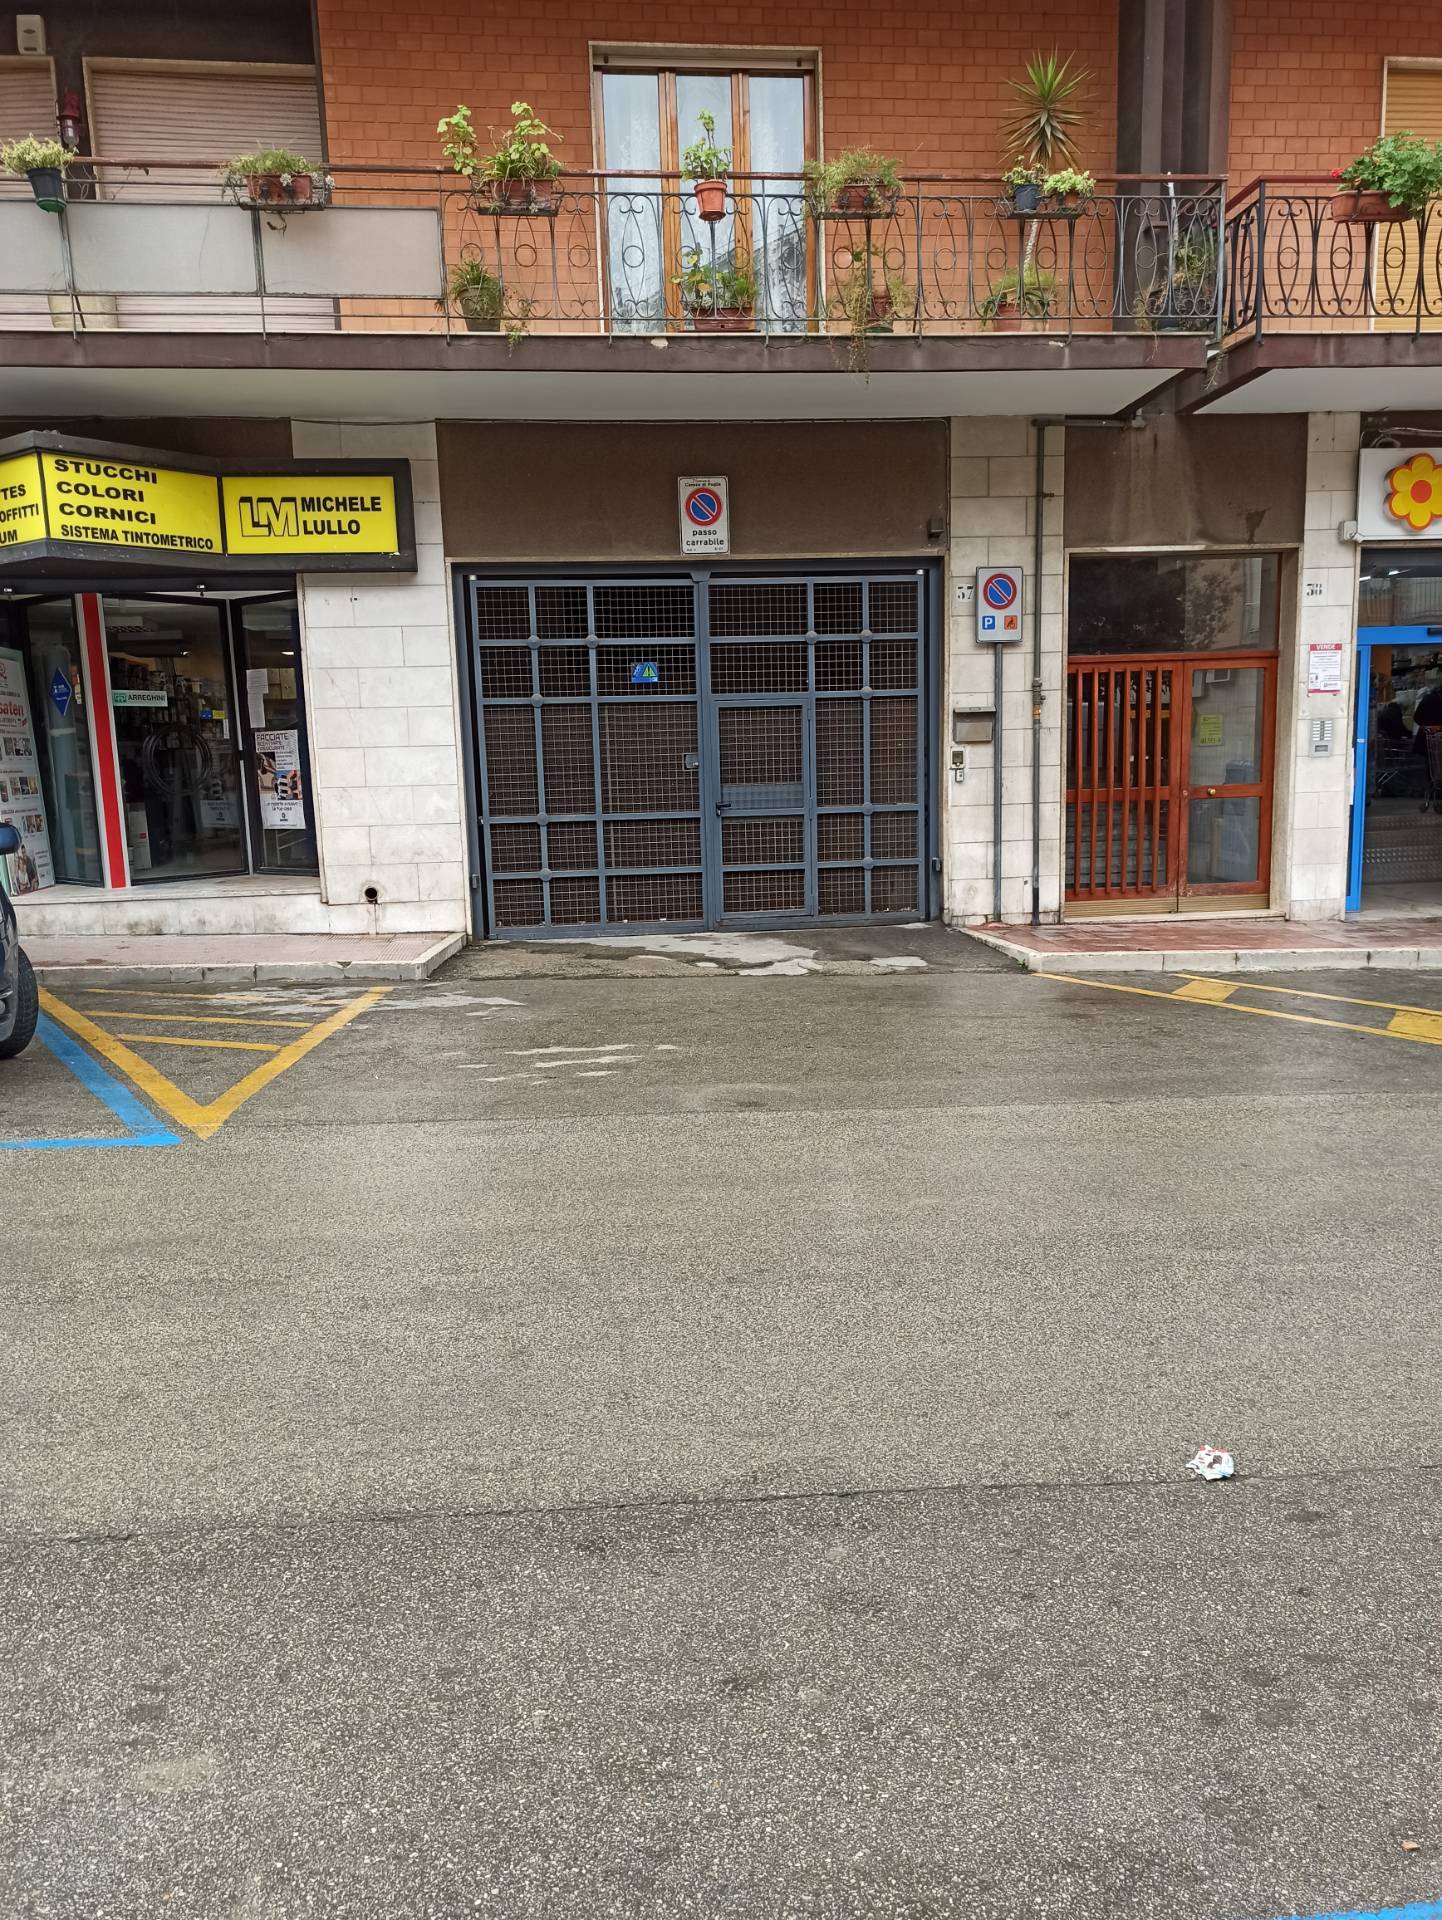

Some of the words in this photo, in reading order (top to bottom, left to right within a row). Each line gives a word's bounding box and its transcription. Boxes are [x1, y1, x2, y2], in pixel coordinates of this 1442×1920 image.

[54, 459, 158, 484] STUCCHI
[56, 481, 145, 502] COLORI
[302, 496, 382, 512] MICHELE
[58, 502, 156, 525] CORNICI
[302, 519, 361, 535] LULLO
[60, 524, 119, 542] SISTEMA
[121, 530, 214, 550] TINTOMETRICO
[984, 617, 992, 628] P
[128, 694, 166, 703] ARREGHINI
[256, 732, 288, 741] FACCIATE
